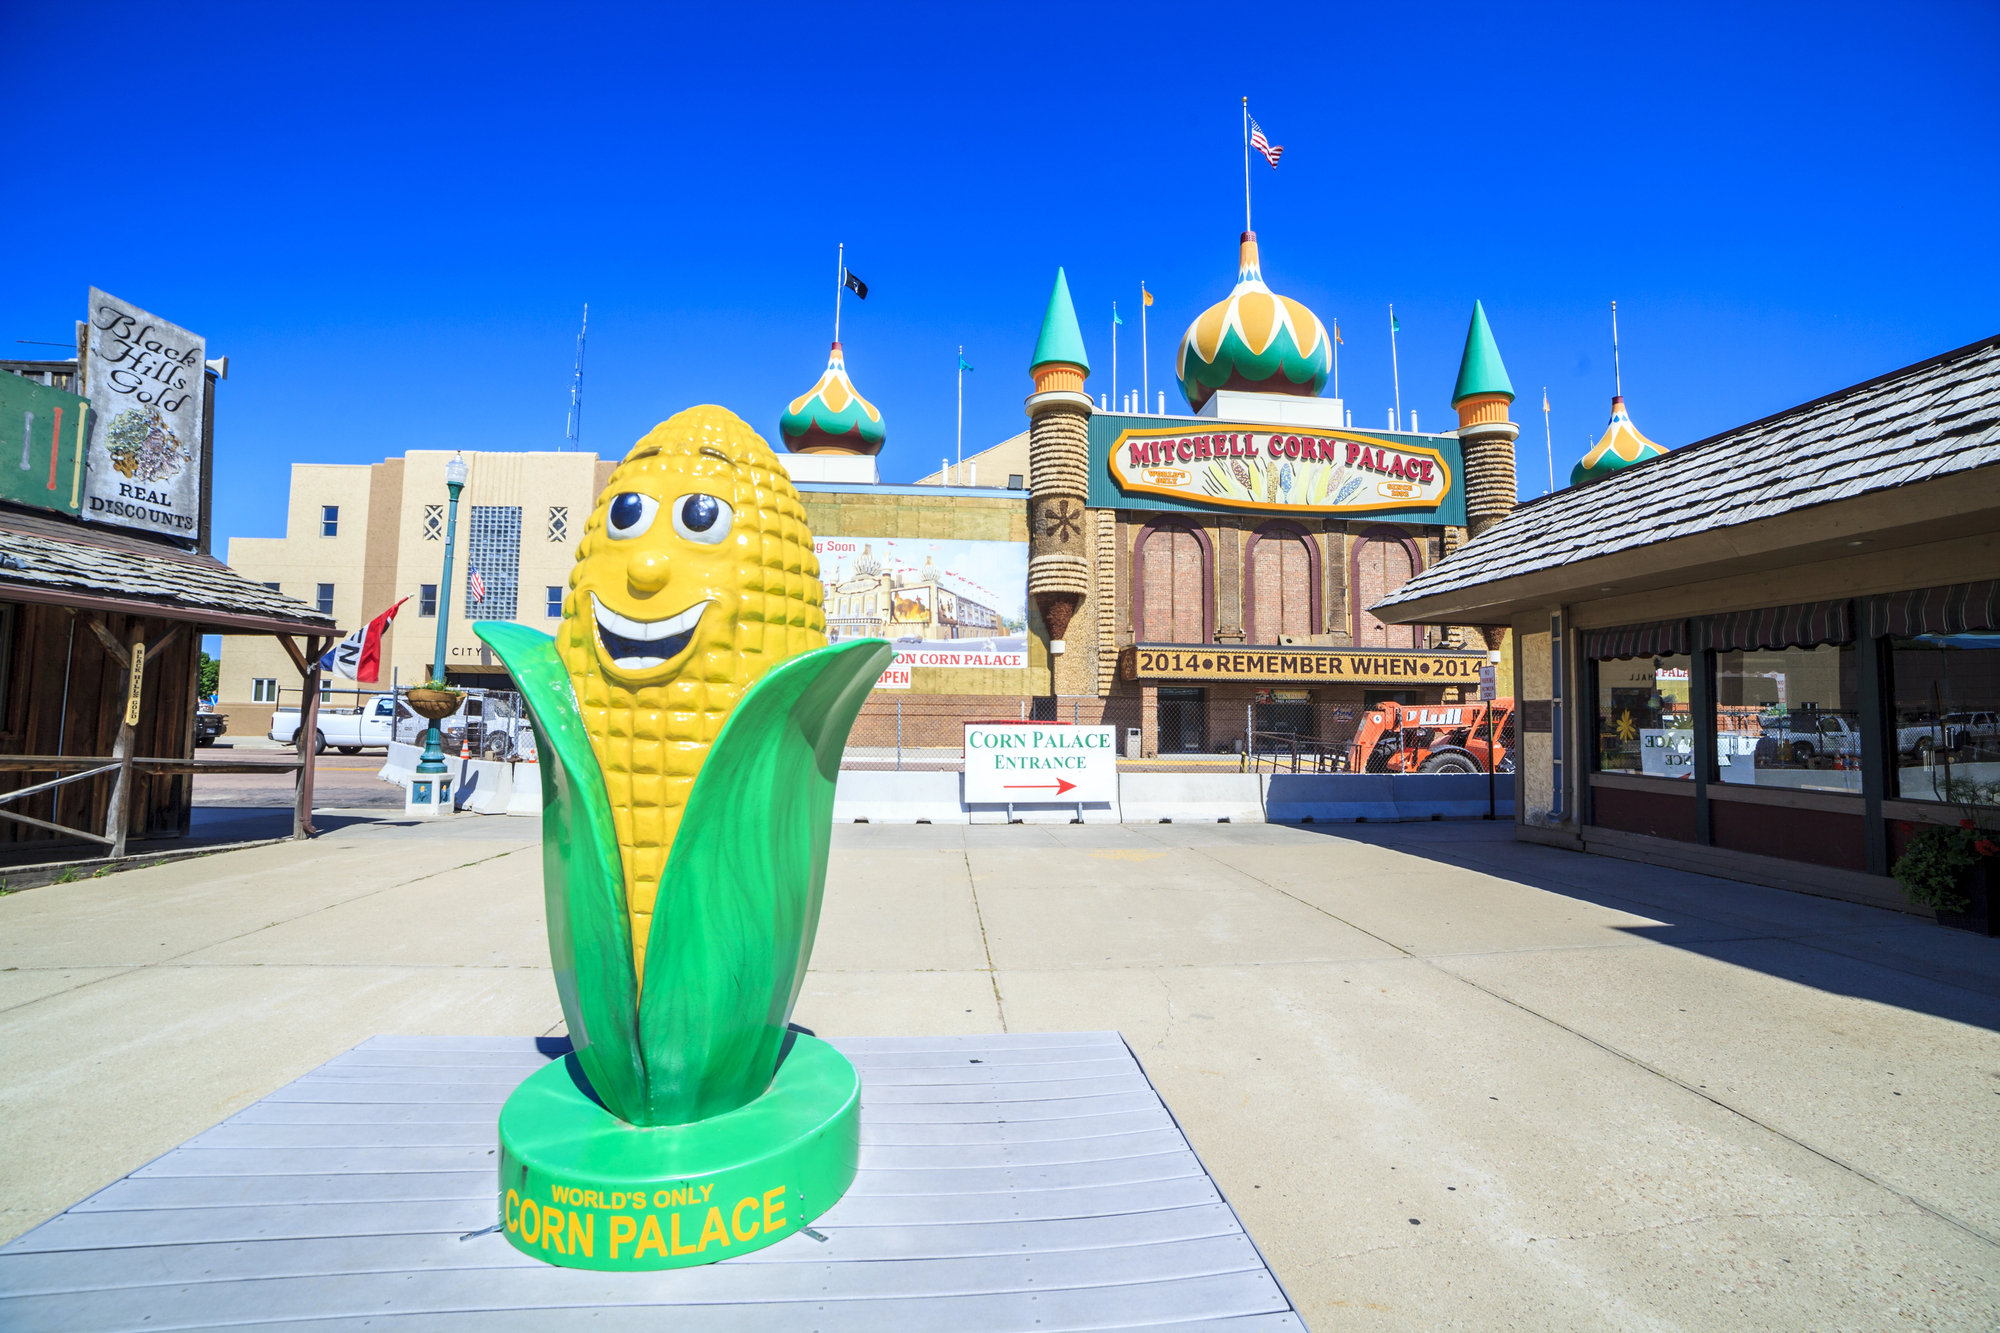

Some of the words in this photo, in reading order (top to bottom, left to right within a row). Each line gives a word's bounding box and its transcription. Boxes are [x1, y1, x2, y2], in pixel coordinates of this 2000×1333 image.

[91, 306, 202, 368] Black
[101, 339, 186, 390] Hills
[107, 369, 192, 412] Gold
[1129, 433, 1259, 467] MITCHELL
[1268, 434, 1336, 463] CORN
[1345, 442, 1435, 484] PALACE
[1148, 470, 1185, 478] WORLD'S
[119, 482, 172, 508] REAL
[1387, 483, 1413, 491] SINCE
[89, 495, 193, 530] DISCOUNTS
[827, 540, 856, 552] Soon
[134, 649, 143, 673] BLACK
[451, 647, 482, 657] CITY
[892, 652, 917, 665] ON
[919, 653, 961, 666] CORN
[964, 654, 1021, 667] PALACE
[1140, 652, 1200, 672] 2014
[1216, 654, 1343, 675] REMEMBER
[1351, 657, 1418, 676] WHEN
[1433, 659, 1483, 677] 2014
[132, 674, 141, 698] HILLS
[1419, 708, 1463, 726] Lull
[969, 730, 1027, 749] CORN
[1032, 730, 1111, 748] PALACE
[994, 754, 1087, 770] ENTRANCE
[551, 1184, 647, 1210] WORLD'S
[653, 1183, 714, 1209] ONLY
[505, 1188, 593, 1258] CORN
[610, 1184, 787, 1259] PALACE
